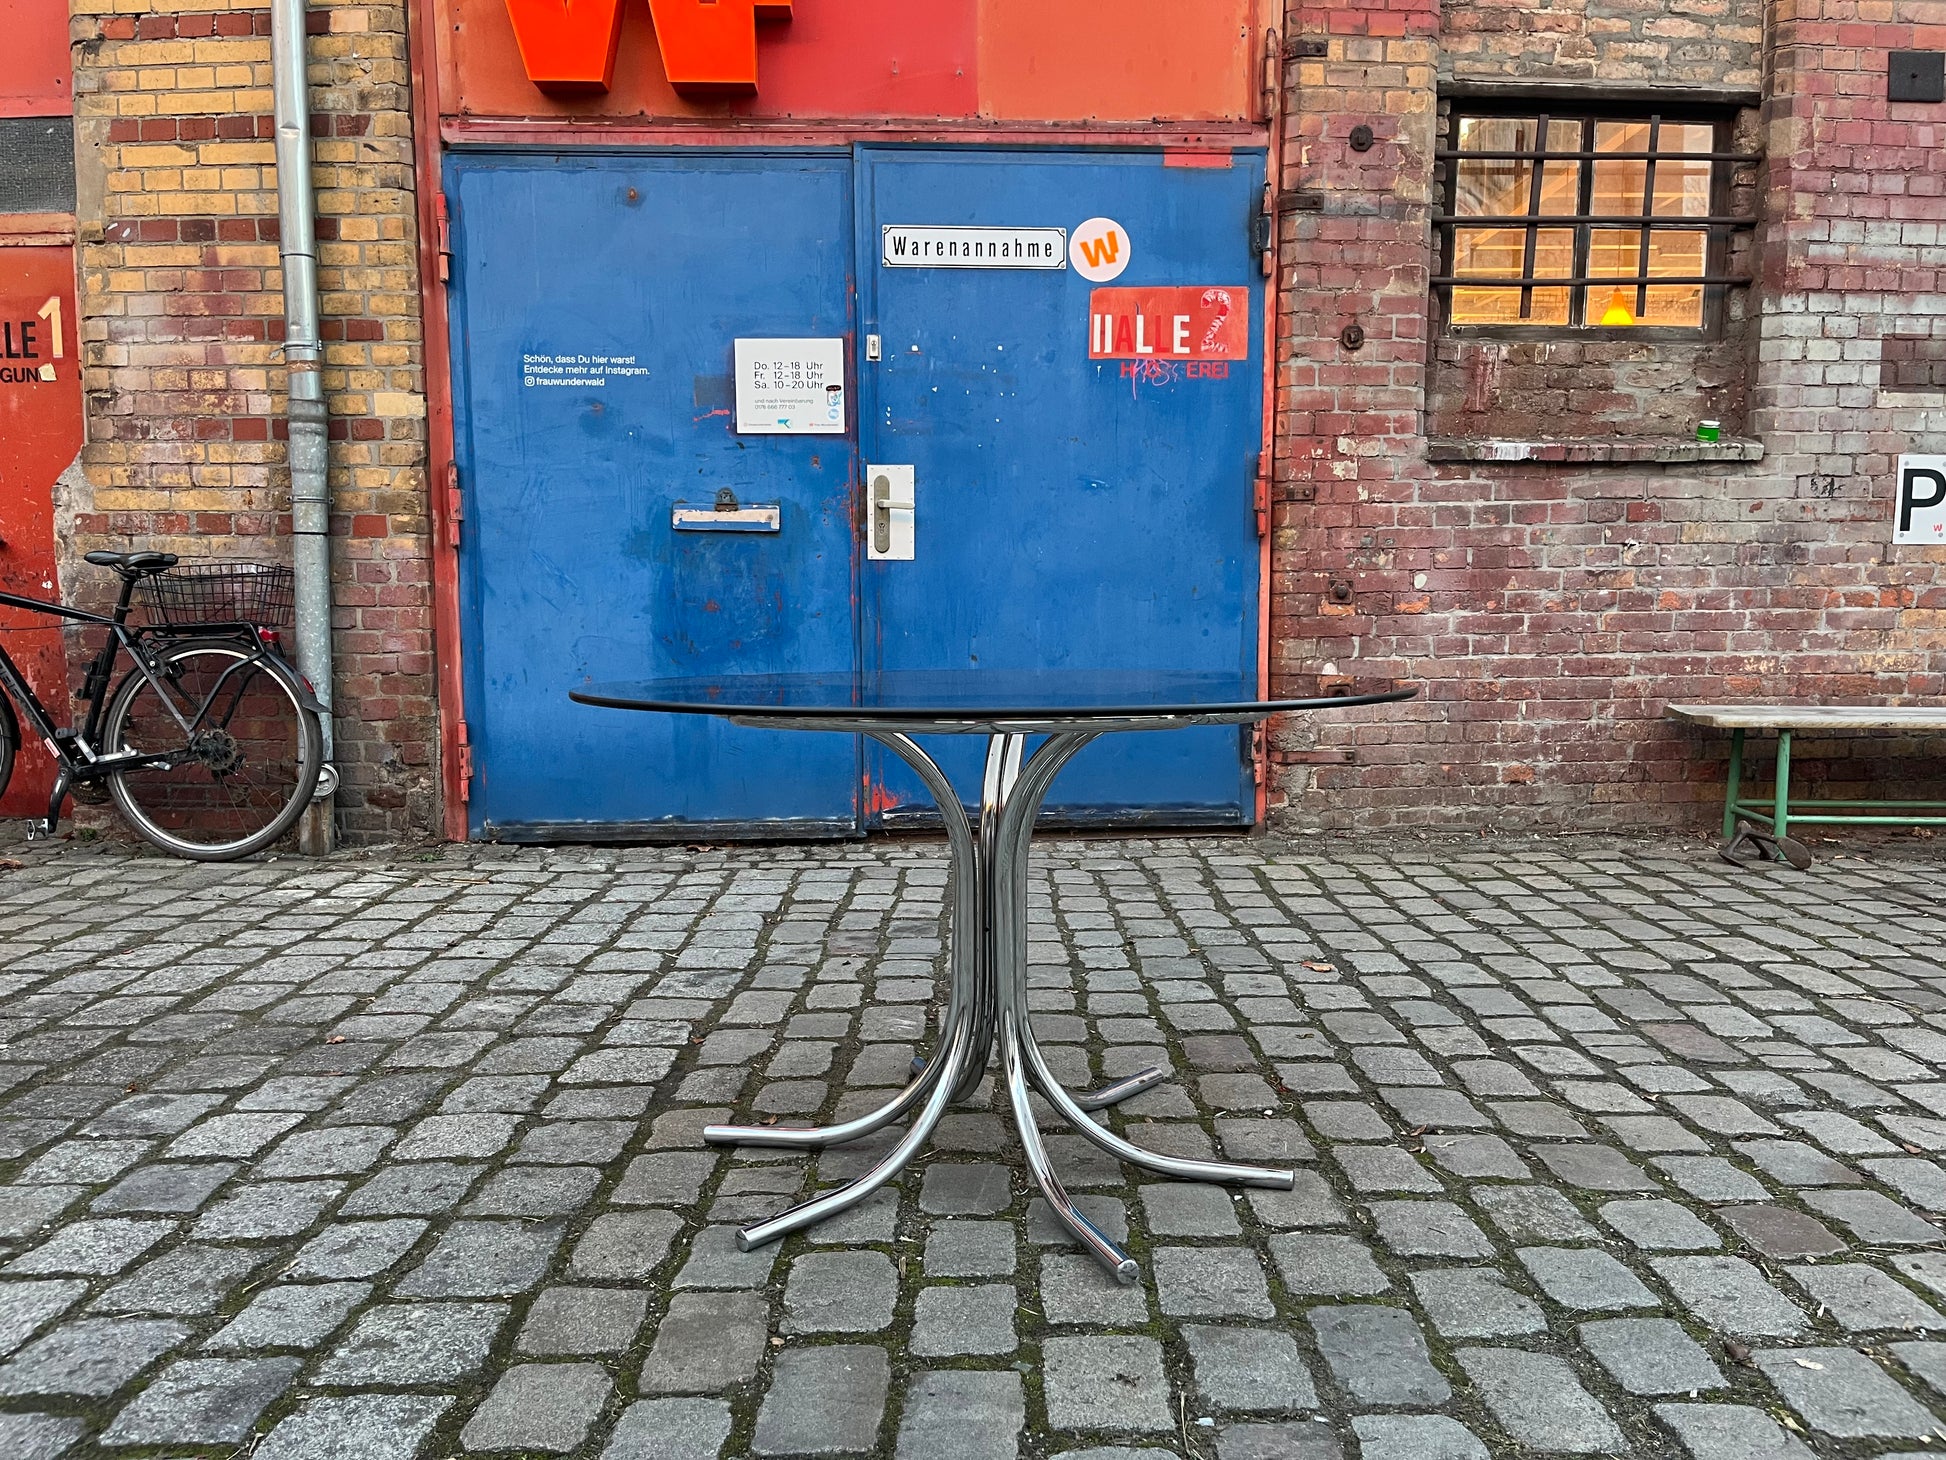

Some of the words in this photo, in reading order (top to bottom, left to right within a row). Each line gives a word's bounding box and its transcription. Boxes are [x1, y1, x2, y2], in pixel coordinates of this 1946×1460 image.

[893, 236, 1053, 258] Warenannahme
[1200, 288, 1232, 352] 2
[0, 321, 38, 358] LE
[37, 296, 64, 358] 1
[523, 354, 554, 364] Schön,
[555, 355, 576, 364] dass
[577, 355, 590, 364] Du
[591, 355, 608, 364] hier
[610, 356, 636, 365] warst!
[524, 365, 563, 374] Entdecke
[565, 365, 588, 374] mehr
[589, 365, 603, 374] auf
[605, 366, 651, 376] Instagram.
[754, 361, 770, 371] Do.
[806, 361, 824, 371] Uhr
[0, 367, 46, 382] GUN
[754, 371, 766, 380] Fr.
[806, 371, 824, 380] Uhr
[536, 377, 605, 386] frauwunderwald
[754, 380, 770, 390] Sa.
[806, 380, 824, 390] Uhr
[1899, 468, 1946, 532] P
